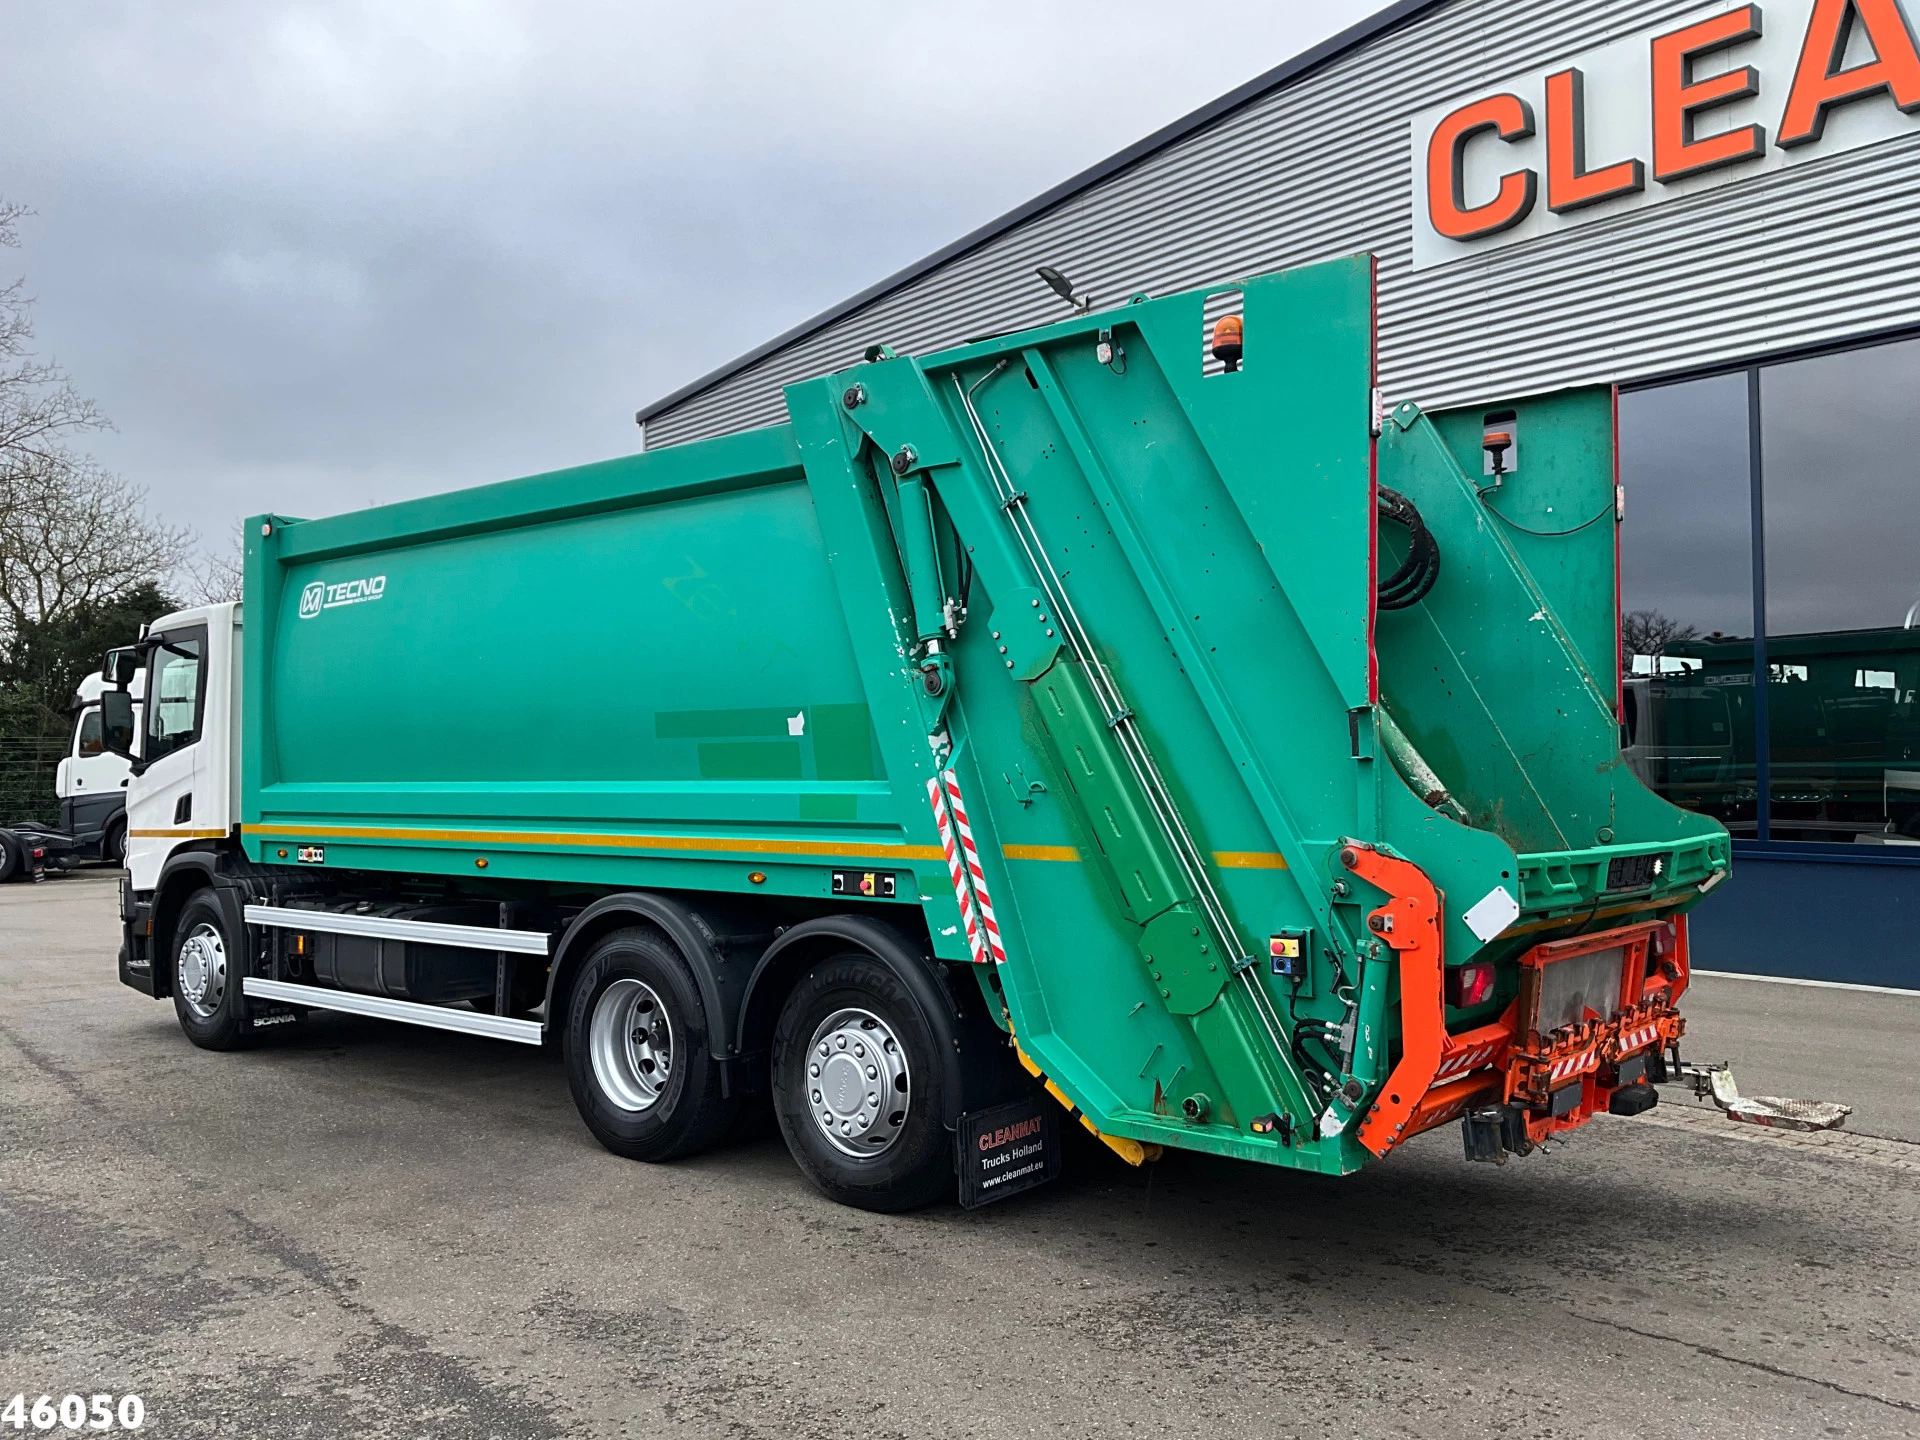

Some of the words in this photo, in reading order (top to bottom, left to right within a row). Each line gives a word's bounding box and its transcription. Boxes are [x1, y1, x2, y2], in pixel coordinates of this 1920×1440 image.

[1427, 0, 1920, 242] CLEA
[326, 576, 387, 602] TECNO
[253, 1013, 297, 1027] SCANIA
[979, 1116, 1042, 1151] CLEANMAT
[982, 1153, 1011, 1170] Trucks
[1012, 1140, 1043, 1160] Holland
[982, 1161, 1044, 1189] www.cleanmat.eu
